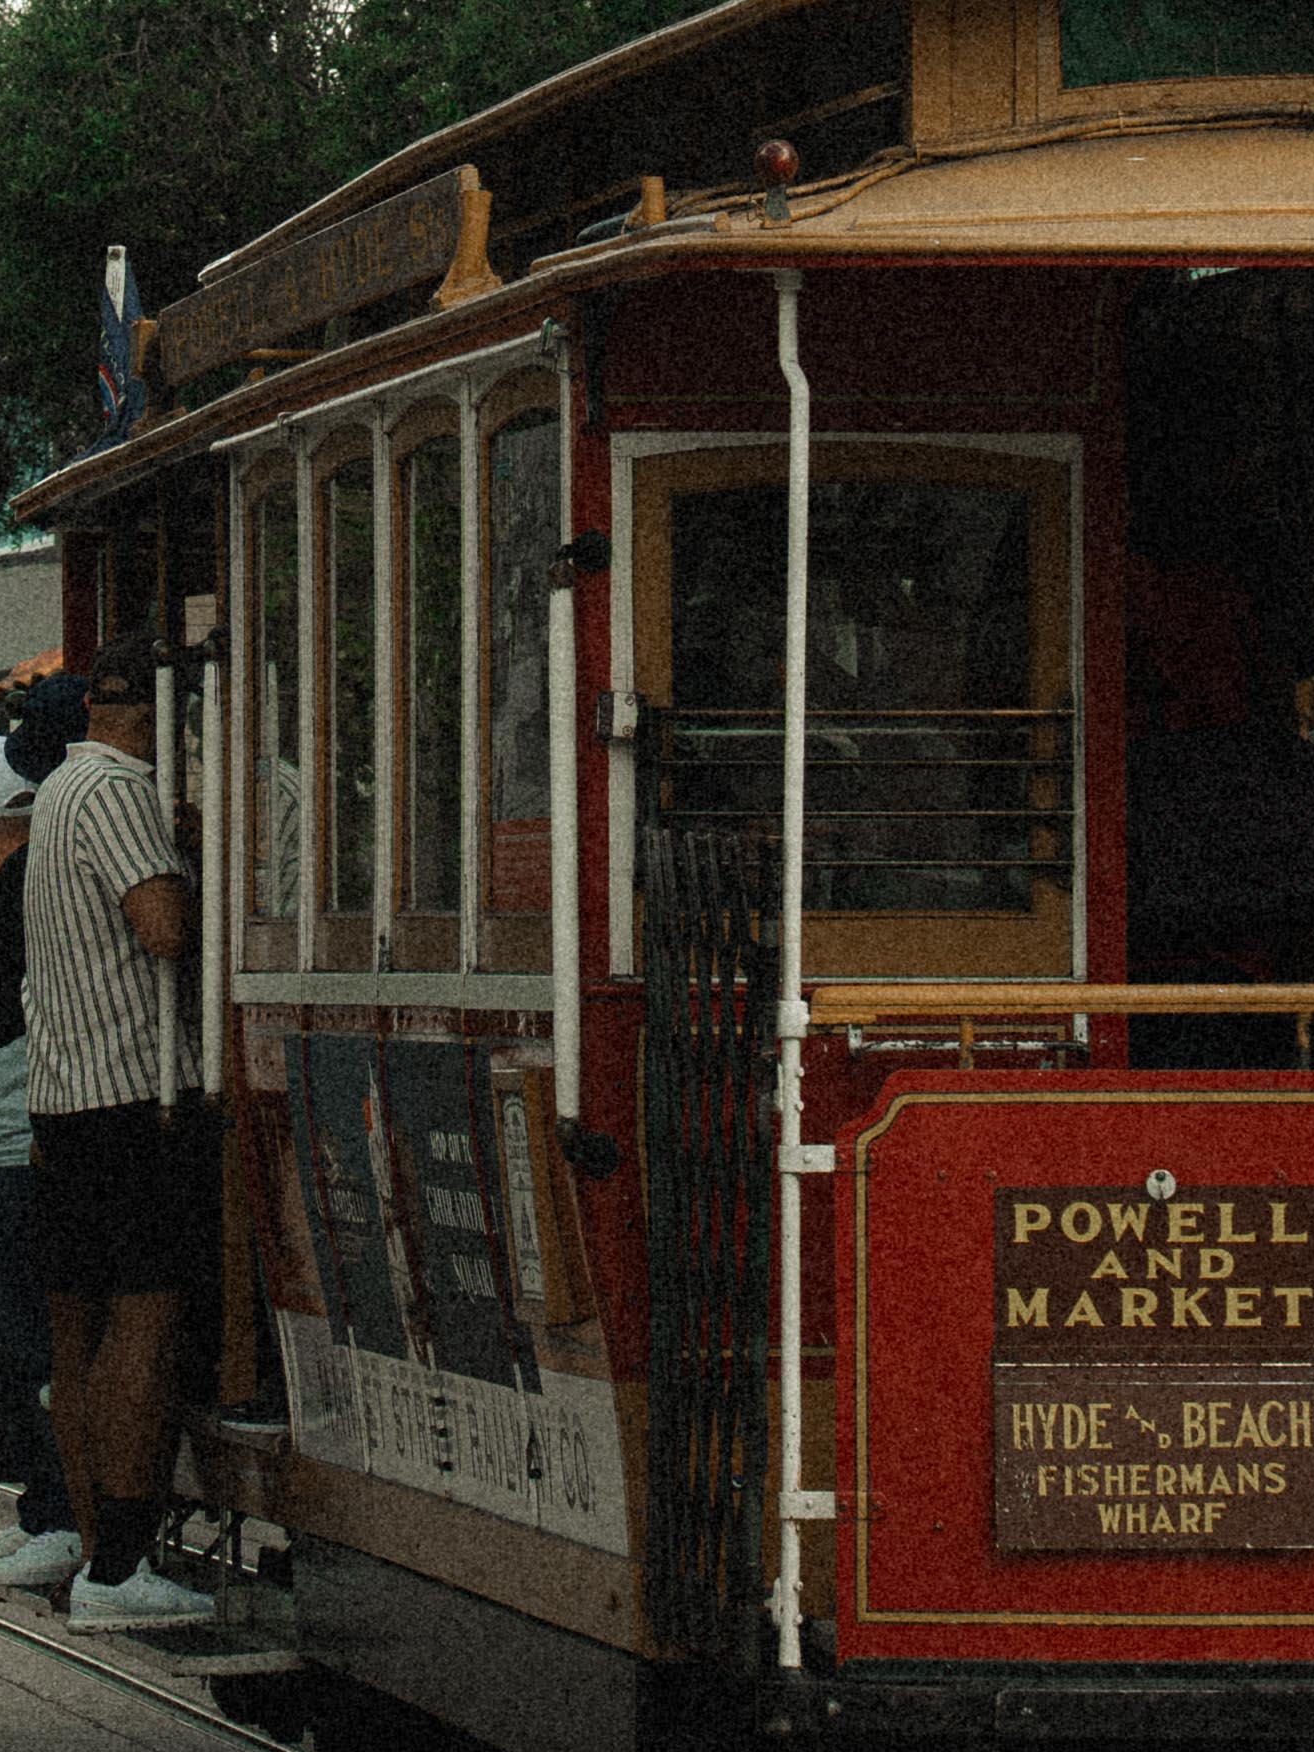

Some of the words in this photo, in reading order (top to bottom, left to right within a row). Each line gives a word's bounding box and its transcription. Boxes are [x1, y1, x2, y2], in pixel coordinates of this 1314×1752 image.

[1011, 1201, 1309, 1244] POWELL
[1090, 1247, 1236, 1280] AND
[1006, 1287, 1314, 1328] MARKET
[1011, 1402, 1114, 1451] HYDE
[1124, 1404, 1173, 1450] AND
[1182, 1400, 1314, 1449] BEACH
[1036, 1461, 1287, 1497] FISHERMANS
[1096, 1502, 1228, 1535] WHARF
